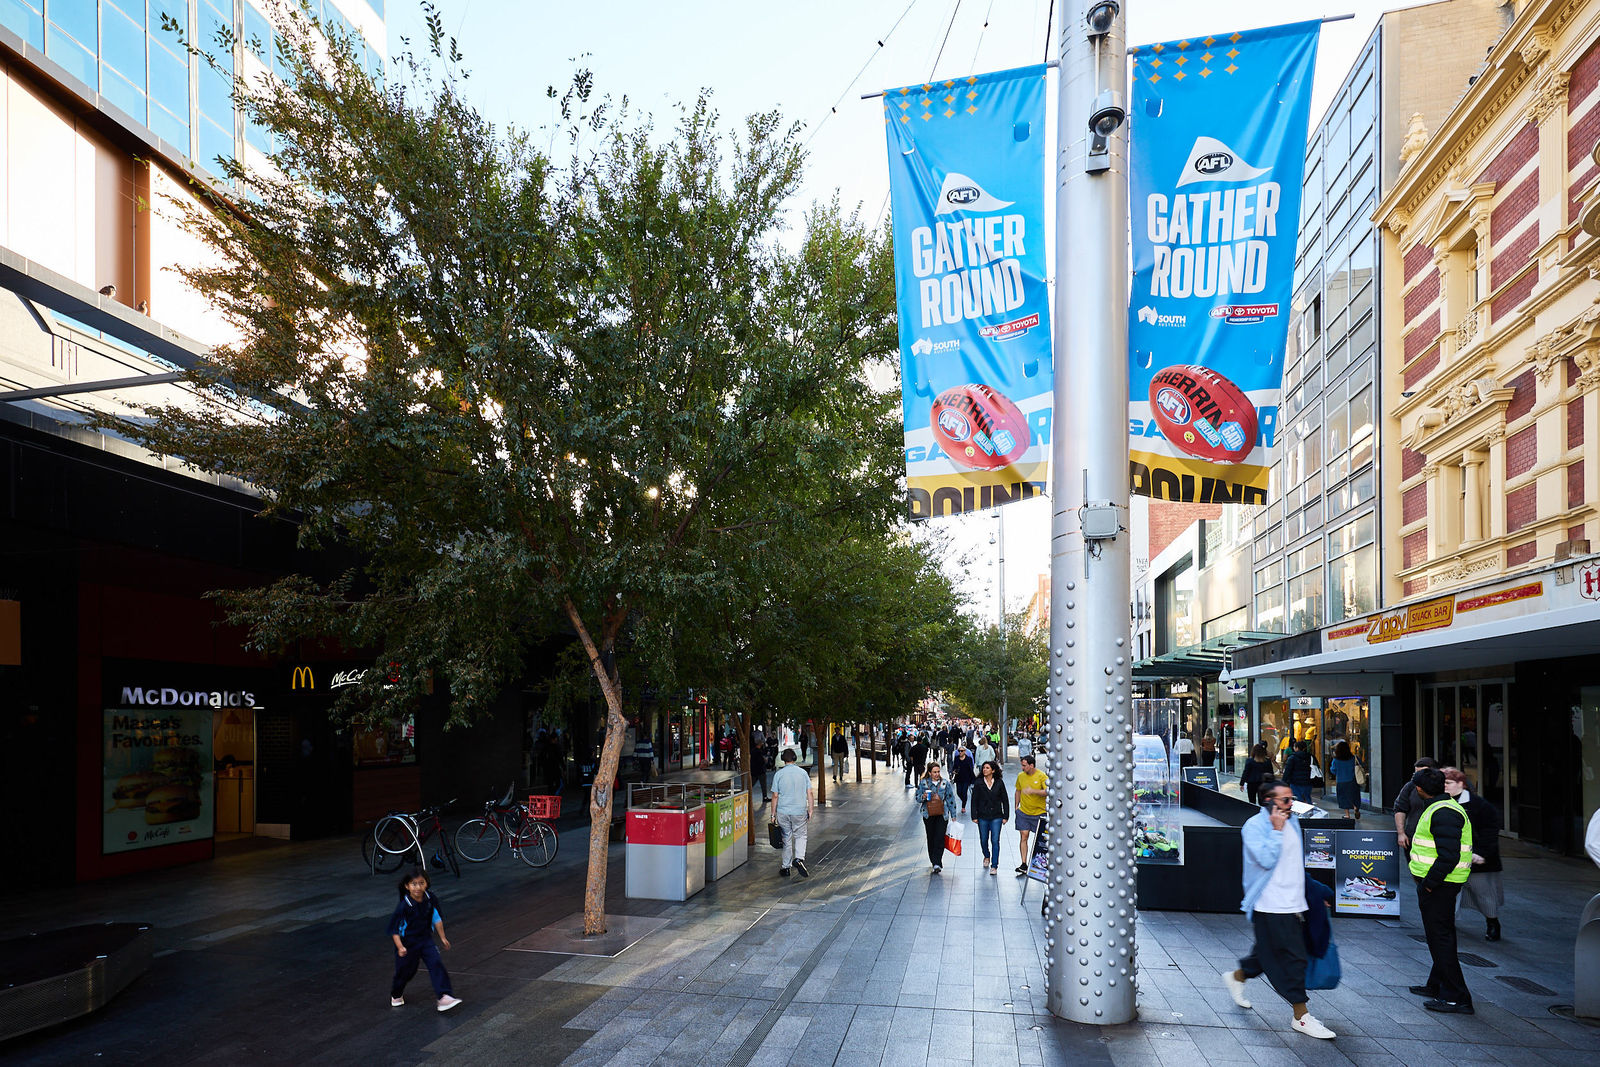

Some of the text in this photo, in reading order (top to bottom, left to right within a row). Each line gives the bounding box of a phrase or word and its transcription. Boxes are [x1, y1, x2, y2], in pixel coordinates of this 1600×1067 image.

[1198, 156, 1230, 170] AFL
[949, 189, 978, 202] AFL
[1147, 181, 1281, 246] GATHER
[911, 214, 1026, 278] GATHER
[1150, 240, 1269, 299] ROUND
[920, 258, 1025, 328] ROUND
[1158, 314, 1186, 323] SOUTH
[1211, 306, 1276, 317] AFL TOYOTA
[1012, 316, 1038, 330] TOYOTA
[933, 339, 960, 351] SOUTH
[1157, 391, 1187, 425] AFL
[939, 410, 968, 441] AFL
[1411, 606, 1448, 623] SNACK BAR
[1367, 612, 1408, 644] Zippy
[121, 686, 256, 707] McDonald's
[112, 715, 182, 730] Macca's
[112, 733, 204, 749] Favourites.
